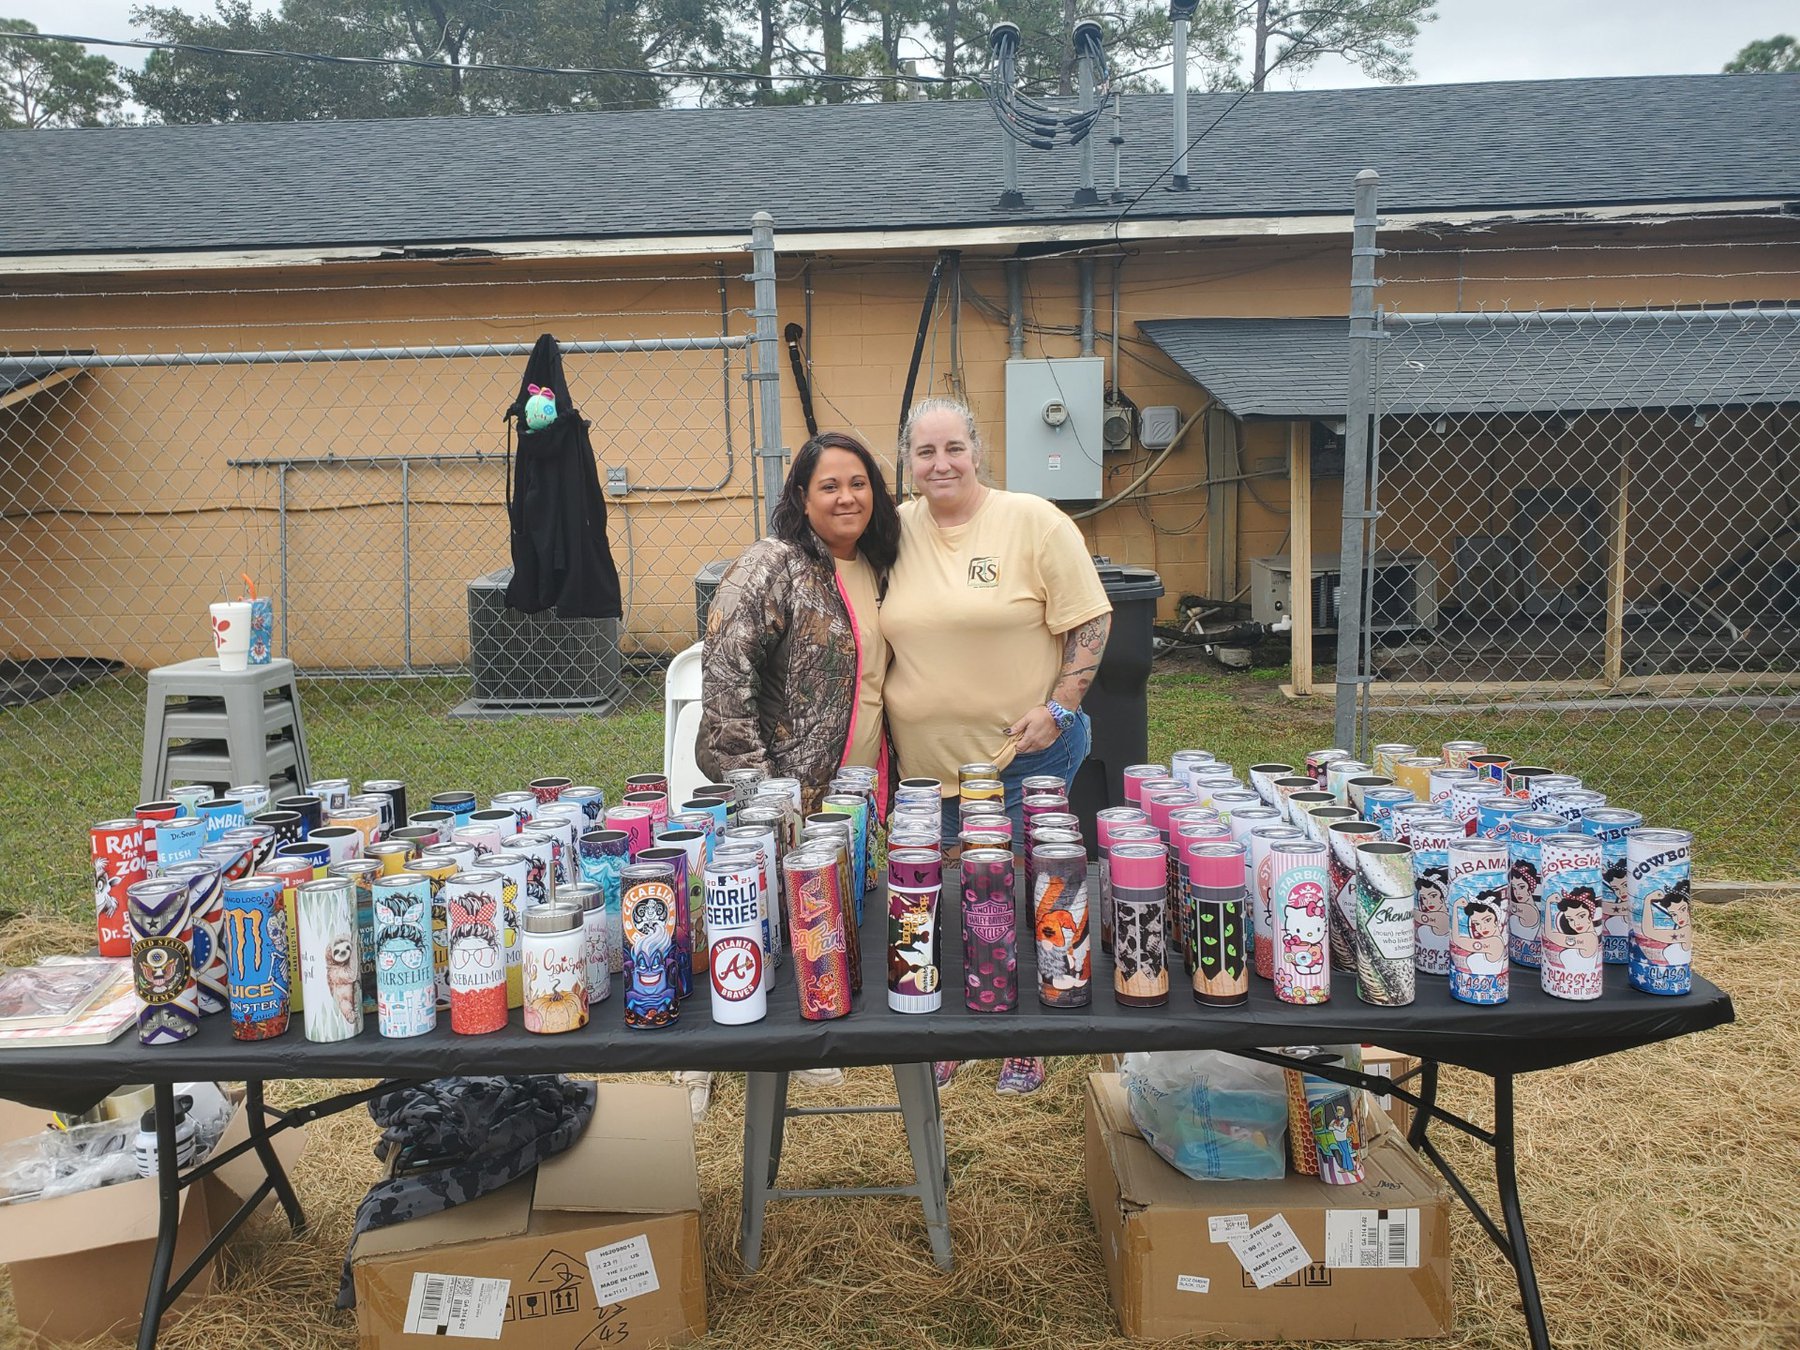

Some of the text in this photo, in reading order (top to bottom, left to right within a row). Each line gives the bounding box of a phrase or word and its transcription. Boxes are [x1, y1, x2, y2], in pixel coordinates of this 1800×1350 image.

[91, 830, 143, 854] I RAN
[121, 849, 139, 860] The
[168, 849, 192, 861] FISH
[115, 855, 147, 876] ZOO
[1278, 870, 1326, 898] STARBUC
[706, 882, 757, 906] WORLD
[707, 903, 758, 925] SERIES
[101, 927, 121, 943] Dr.
[715, 940, 752, 953] ATLANTA
[1548, 968, 1587, 986] CLASSY
[145, 991, 176, 1002] ARMY
[721, 984, 755, 1000] BRAVES
[1252, 1260, 1270, 1273] MADE
[1270, 1255, 1278, 1263] IN
[1277, 1245, 1298, 1258] CHINA
[600, 1279, 619, 1289] MADE
[628, 1270, 650, 1281] CHINA
